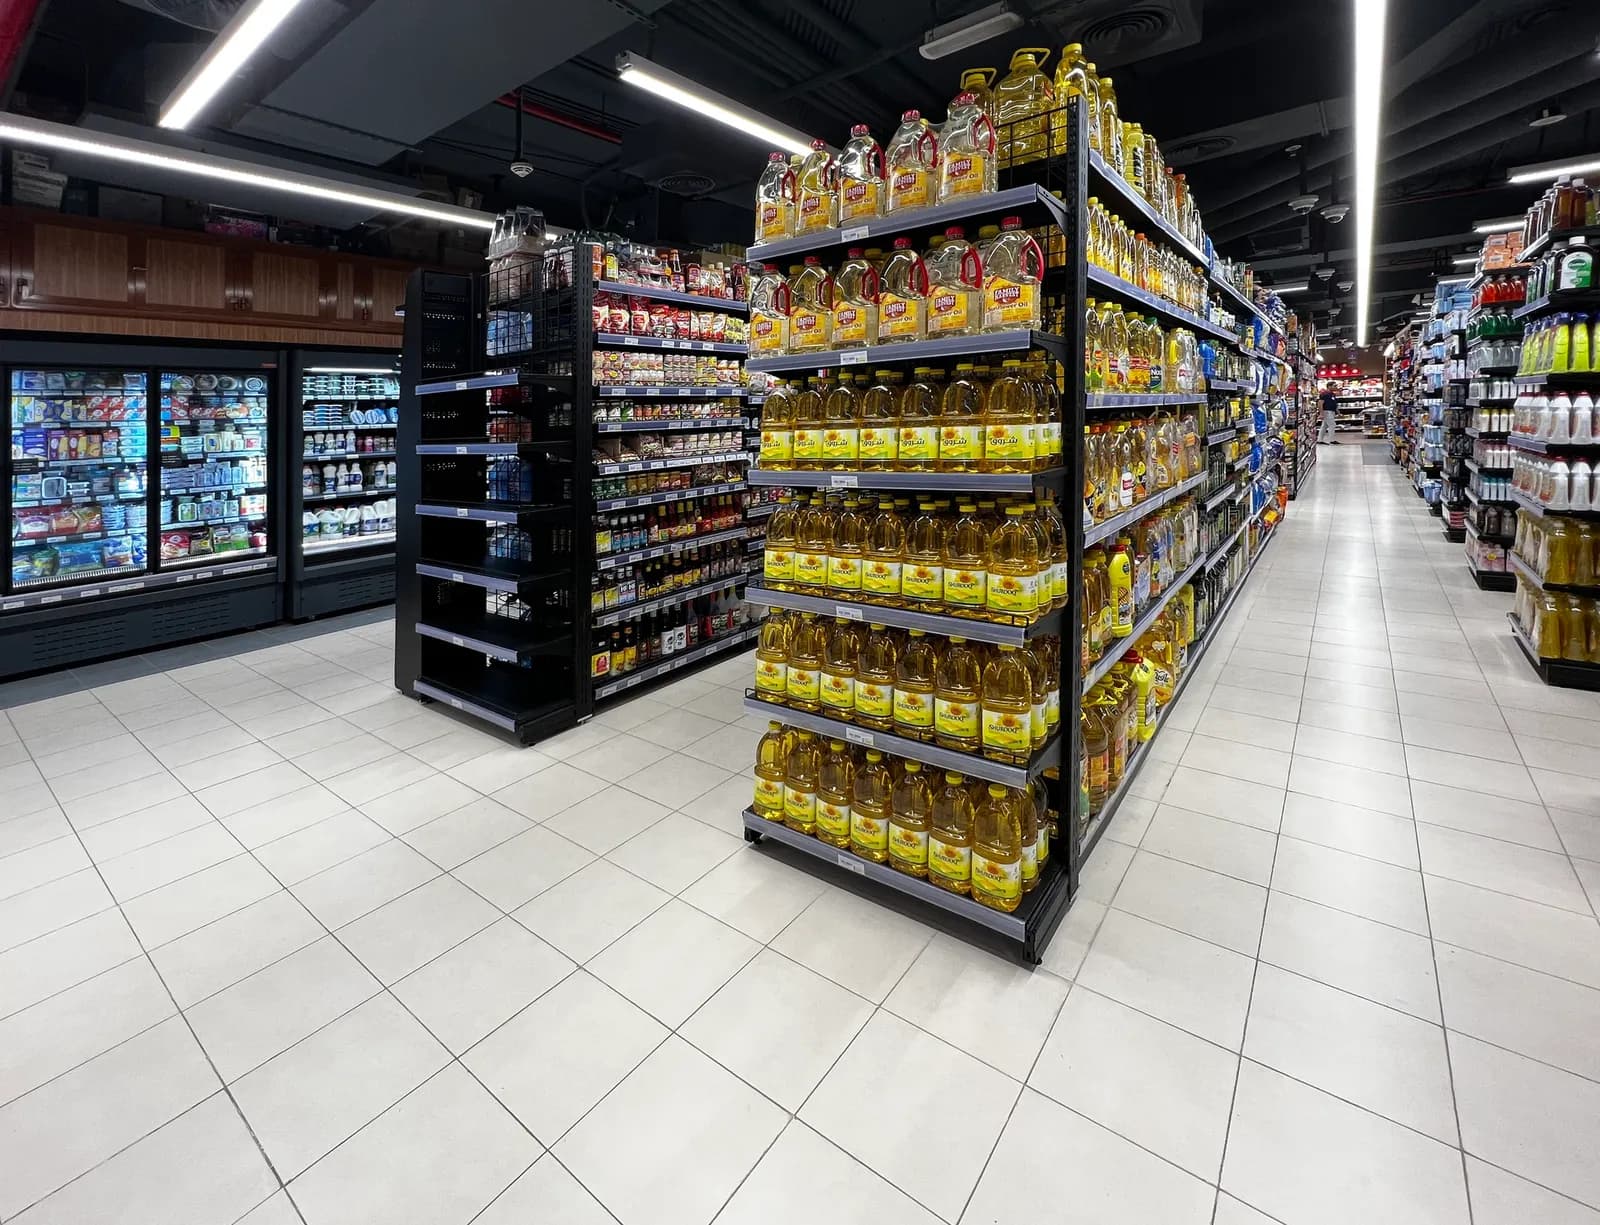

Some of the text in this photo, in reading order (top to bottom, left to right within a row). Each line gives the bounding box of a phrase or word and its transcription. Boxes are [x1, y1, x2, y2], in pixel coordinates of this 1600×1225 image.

[995, 286, 1020, 297] FAMILY
[902, 438, 925, 447] شروق
[943, 437, 967, 447] شروق
[990, 435, 1018, 446] شروق
[988, 723, 1020, 734] SHUROOQ
